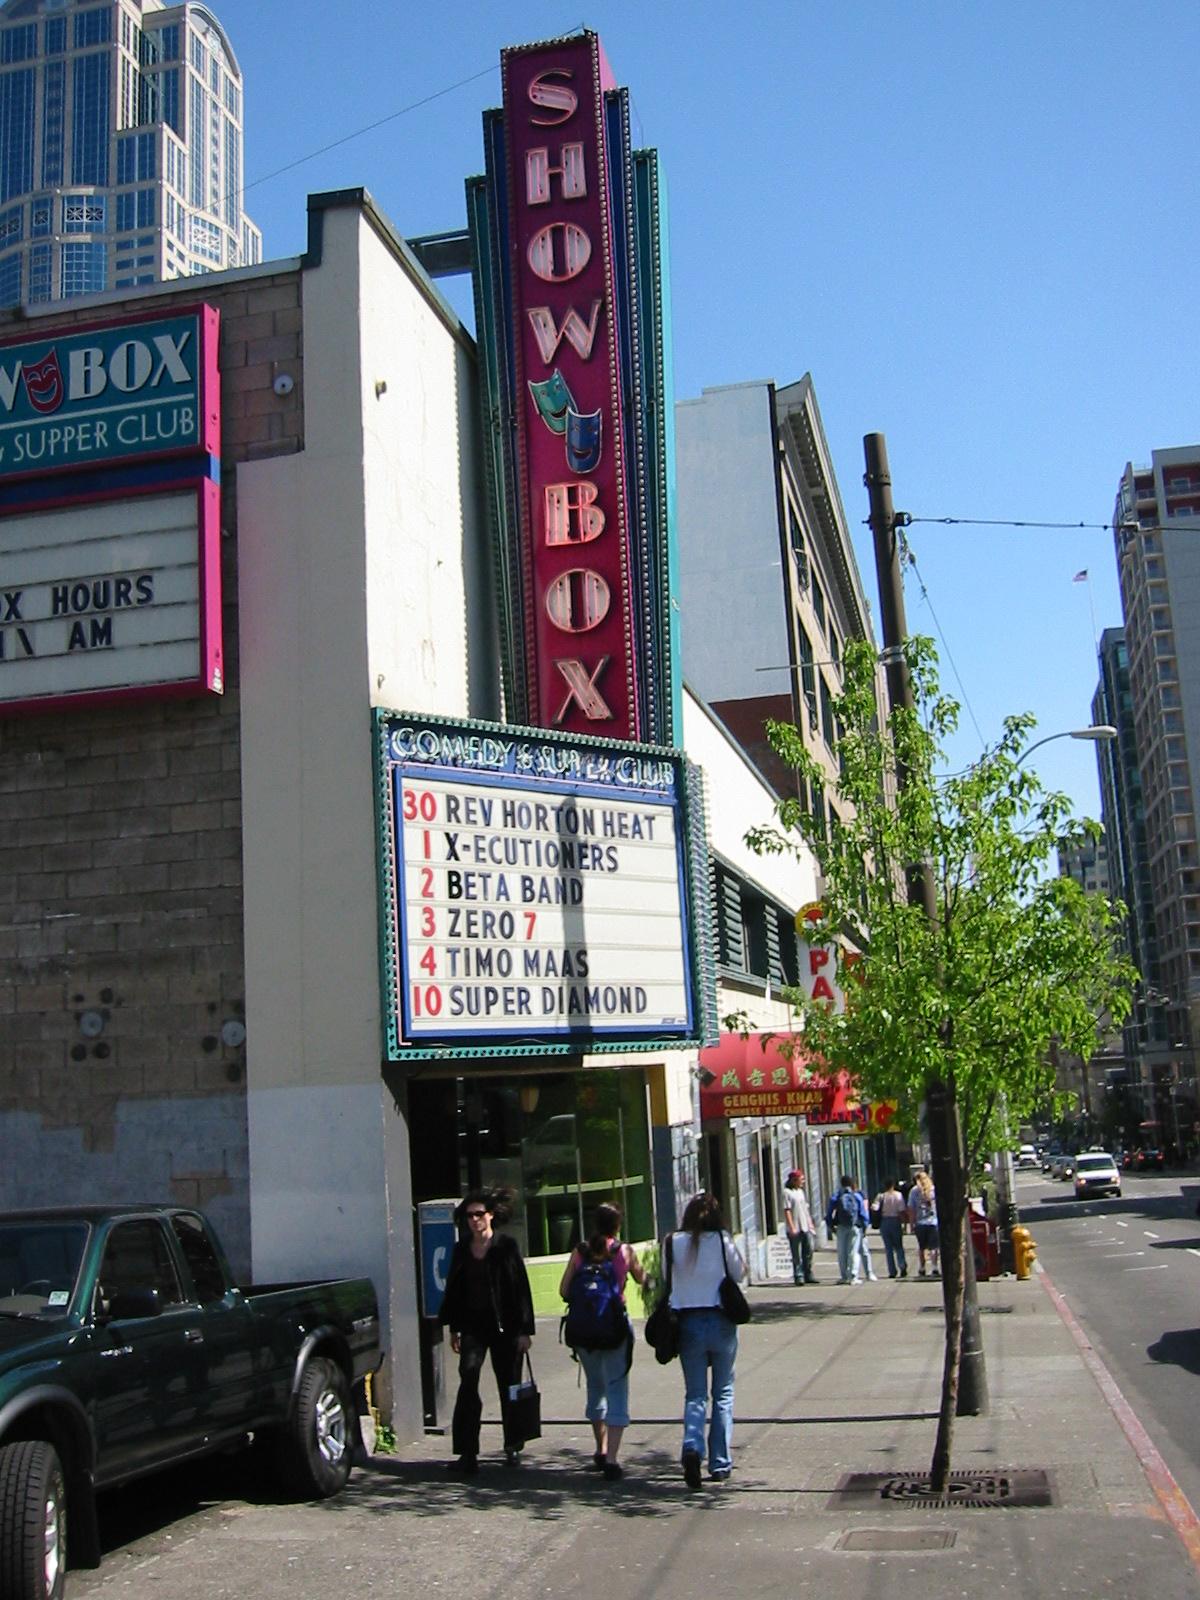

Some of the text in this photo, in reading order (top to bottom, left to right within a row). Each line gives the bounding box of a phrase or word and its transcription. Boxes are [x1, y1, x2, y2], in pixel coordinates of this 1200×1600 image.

[68, 331, 192, 401] BOX
[525, 68, 613, 724] SHOW BOX
[13, 420, 108, 462] SUPPER
[117, 407, 194, 445] CLUB
[52, 575, 154, 615] HOURS
[69, 617, 112, 650] AM
[391, 727, 514, 768] COMEDY
[616, 756, 675, 786] CLUB
[403, 790, 656, 841] 30 REV HORTON HEAT
[423, 830, 619, 873] 1 X-ECUTIONERS
[421, 870, 584, 906] 2 BETA BAND
[421, 908, 537, 940] 3 ZERO 7
[420, 946, 590, 979] 4 TIMO MAAS
[413, 985, 648, 1017] 10 SUPER DIAMOND
[723, 1093, 780, 1107] GENGHIS
